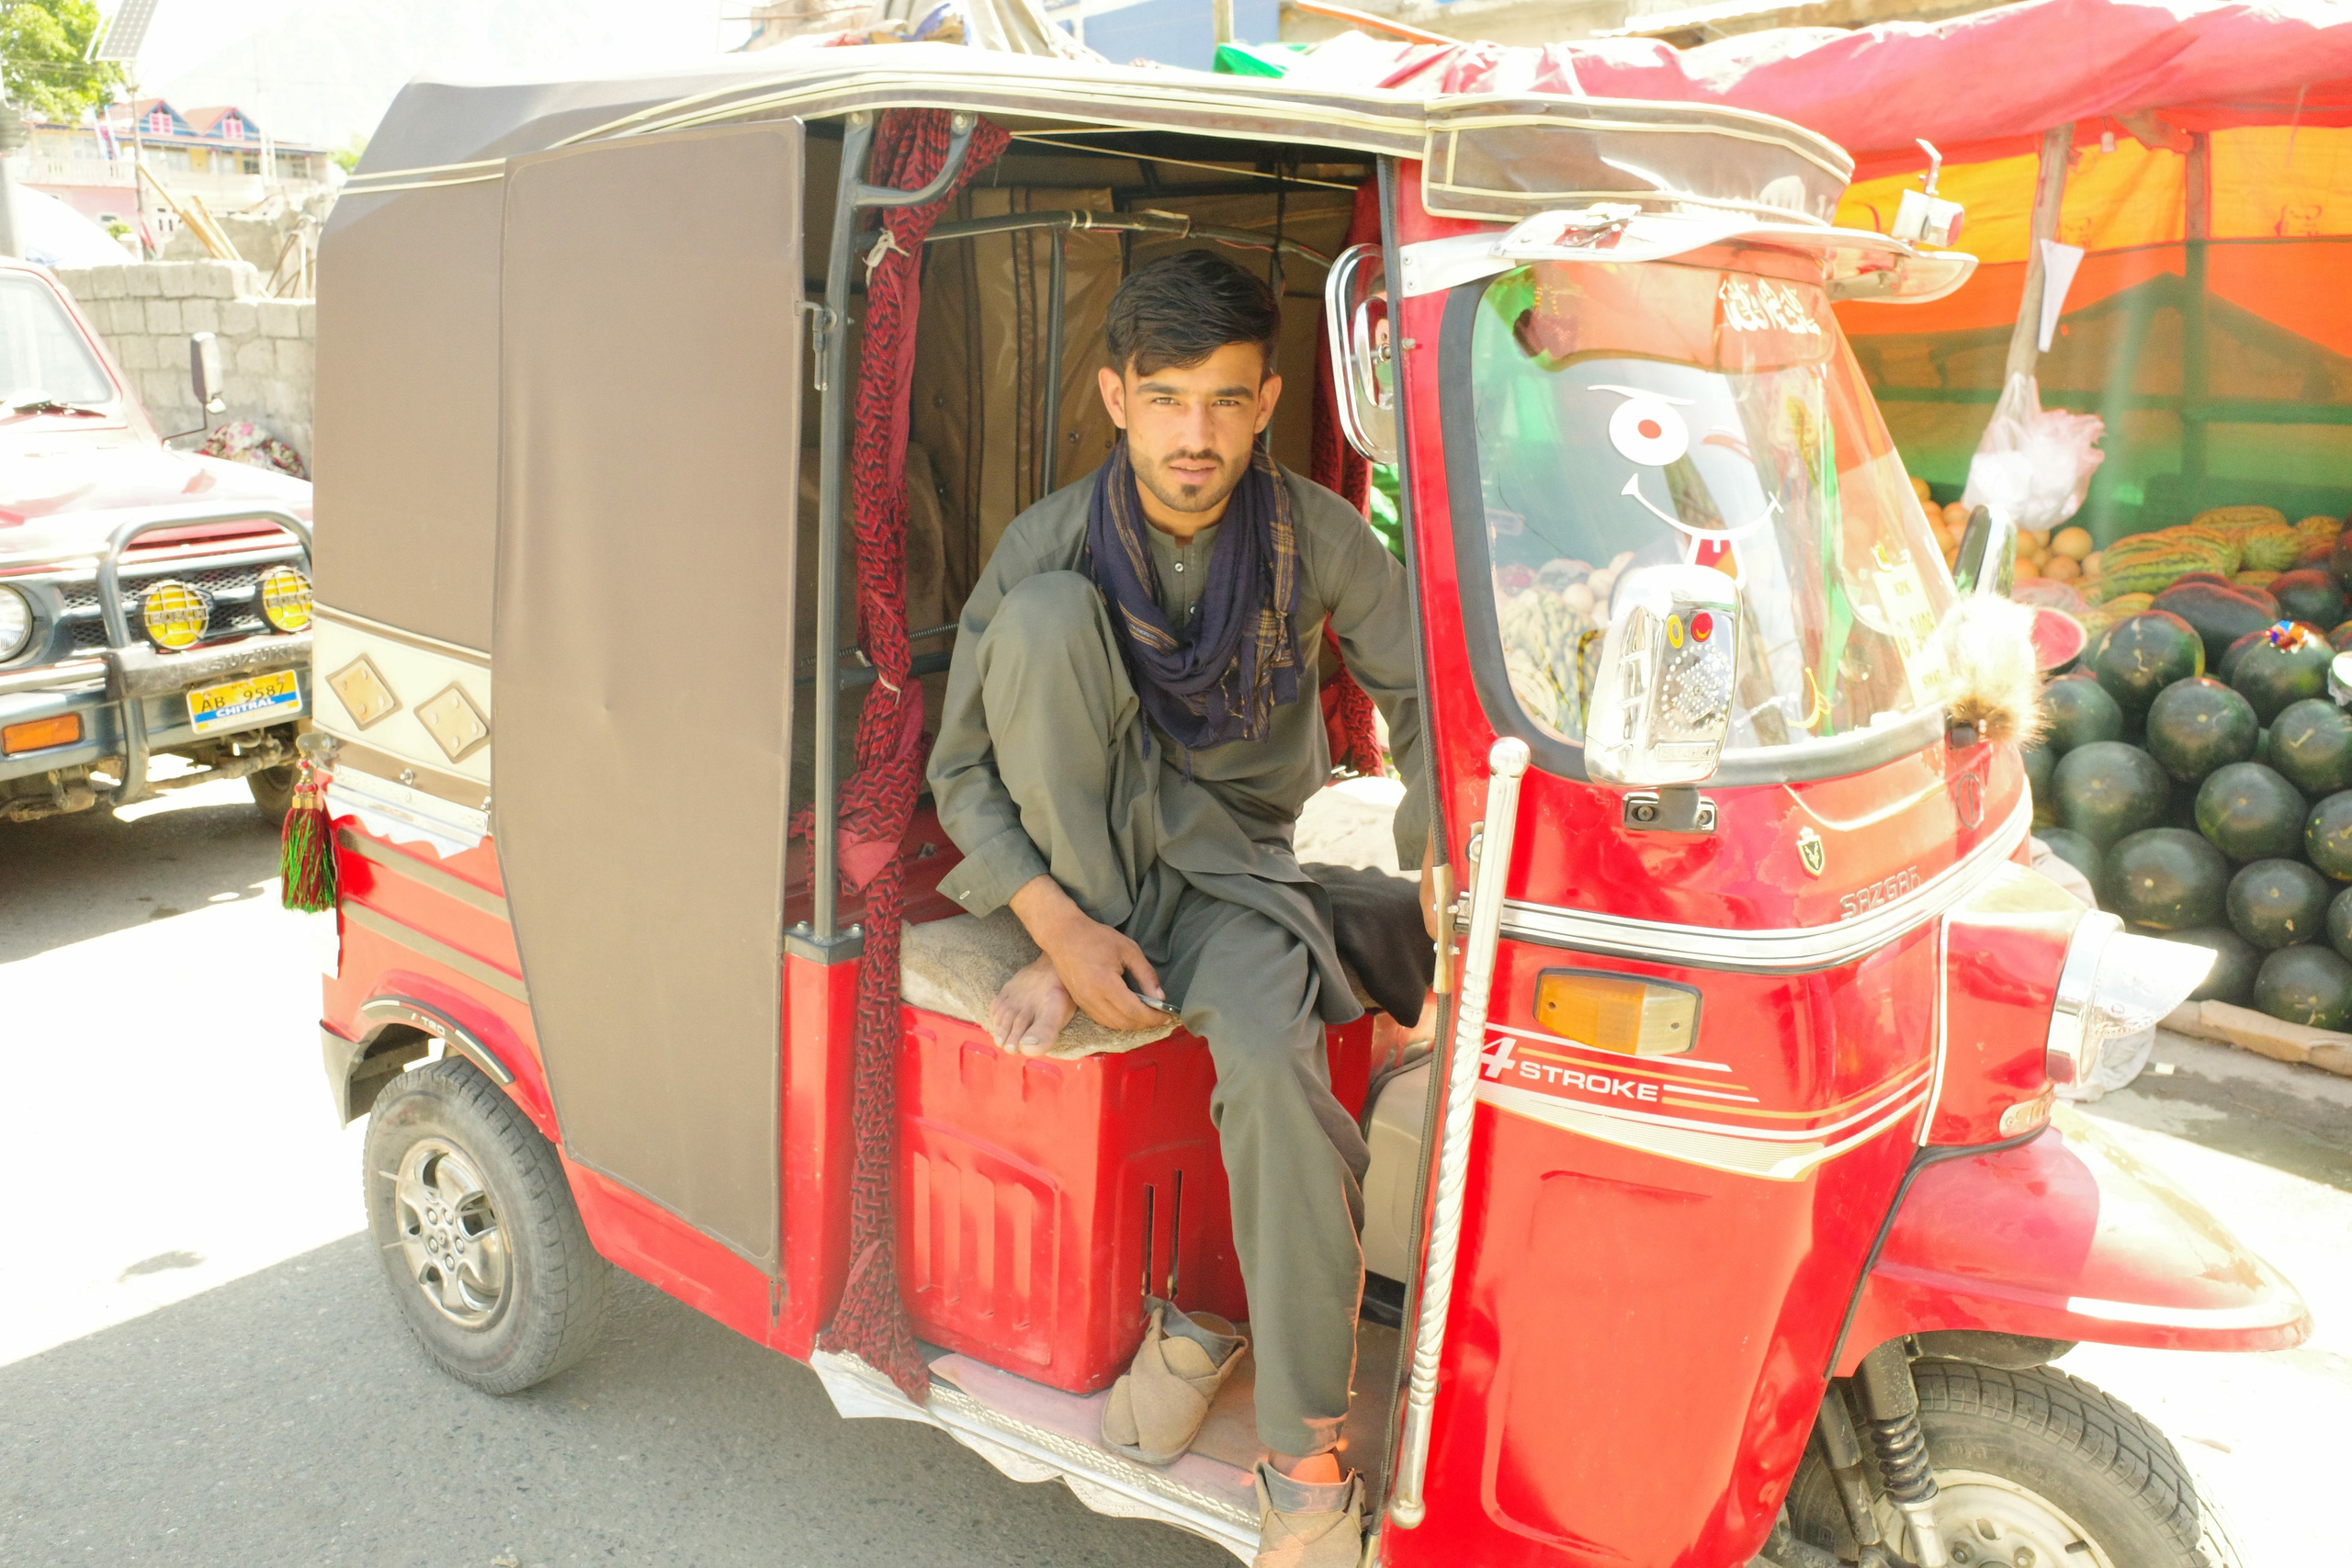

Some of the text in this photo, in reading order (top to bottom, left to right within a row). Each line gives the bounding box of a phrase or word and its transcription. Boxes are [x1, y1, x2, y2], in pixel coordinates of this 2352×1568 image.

[201, 682, 285, 712] AB 9587
[215, 697, 276, 717] CHITRAL
[1839, 864, 1920, 919] SAZGAR
[1481, 1036, 1659, 1102] 4 STROKE
